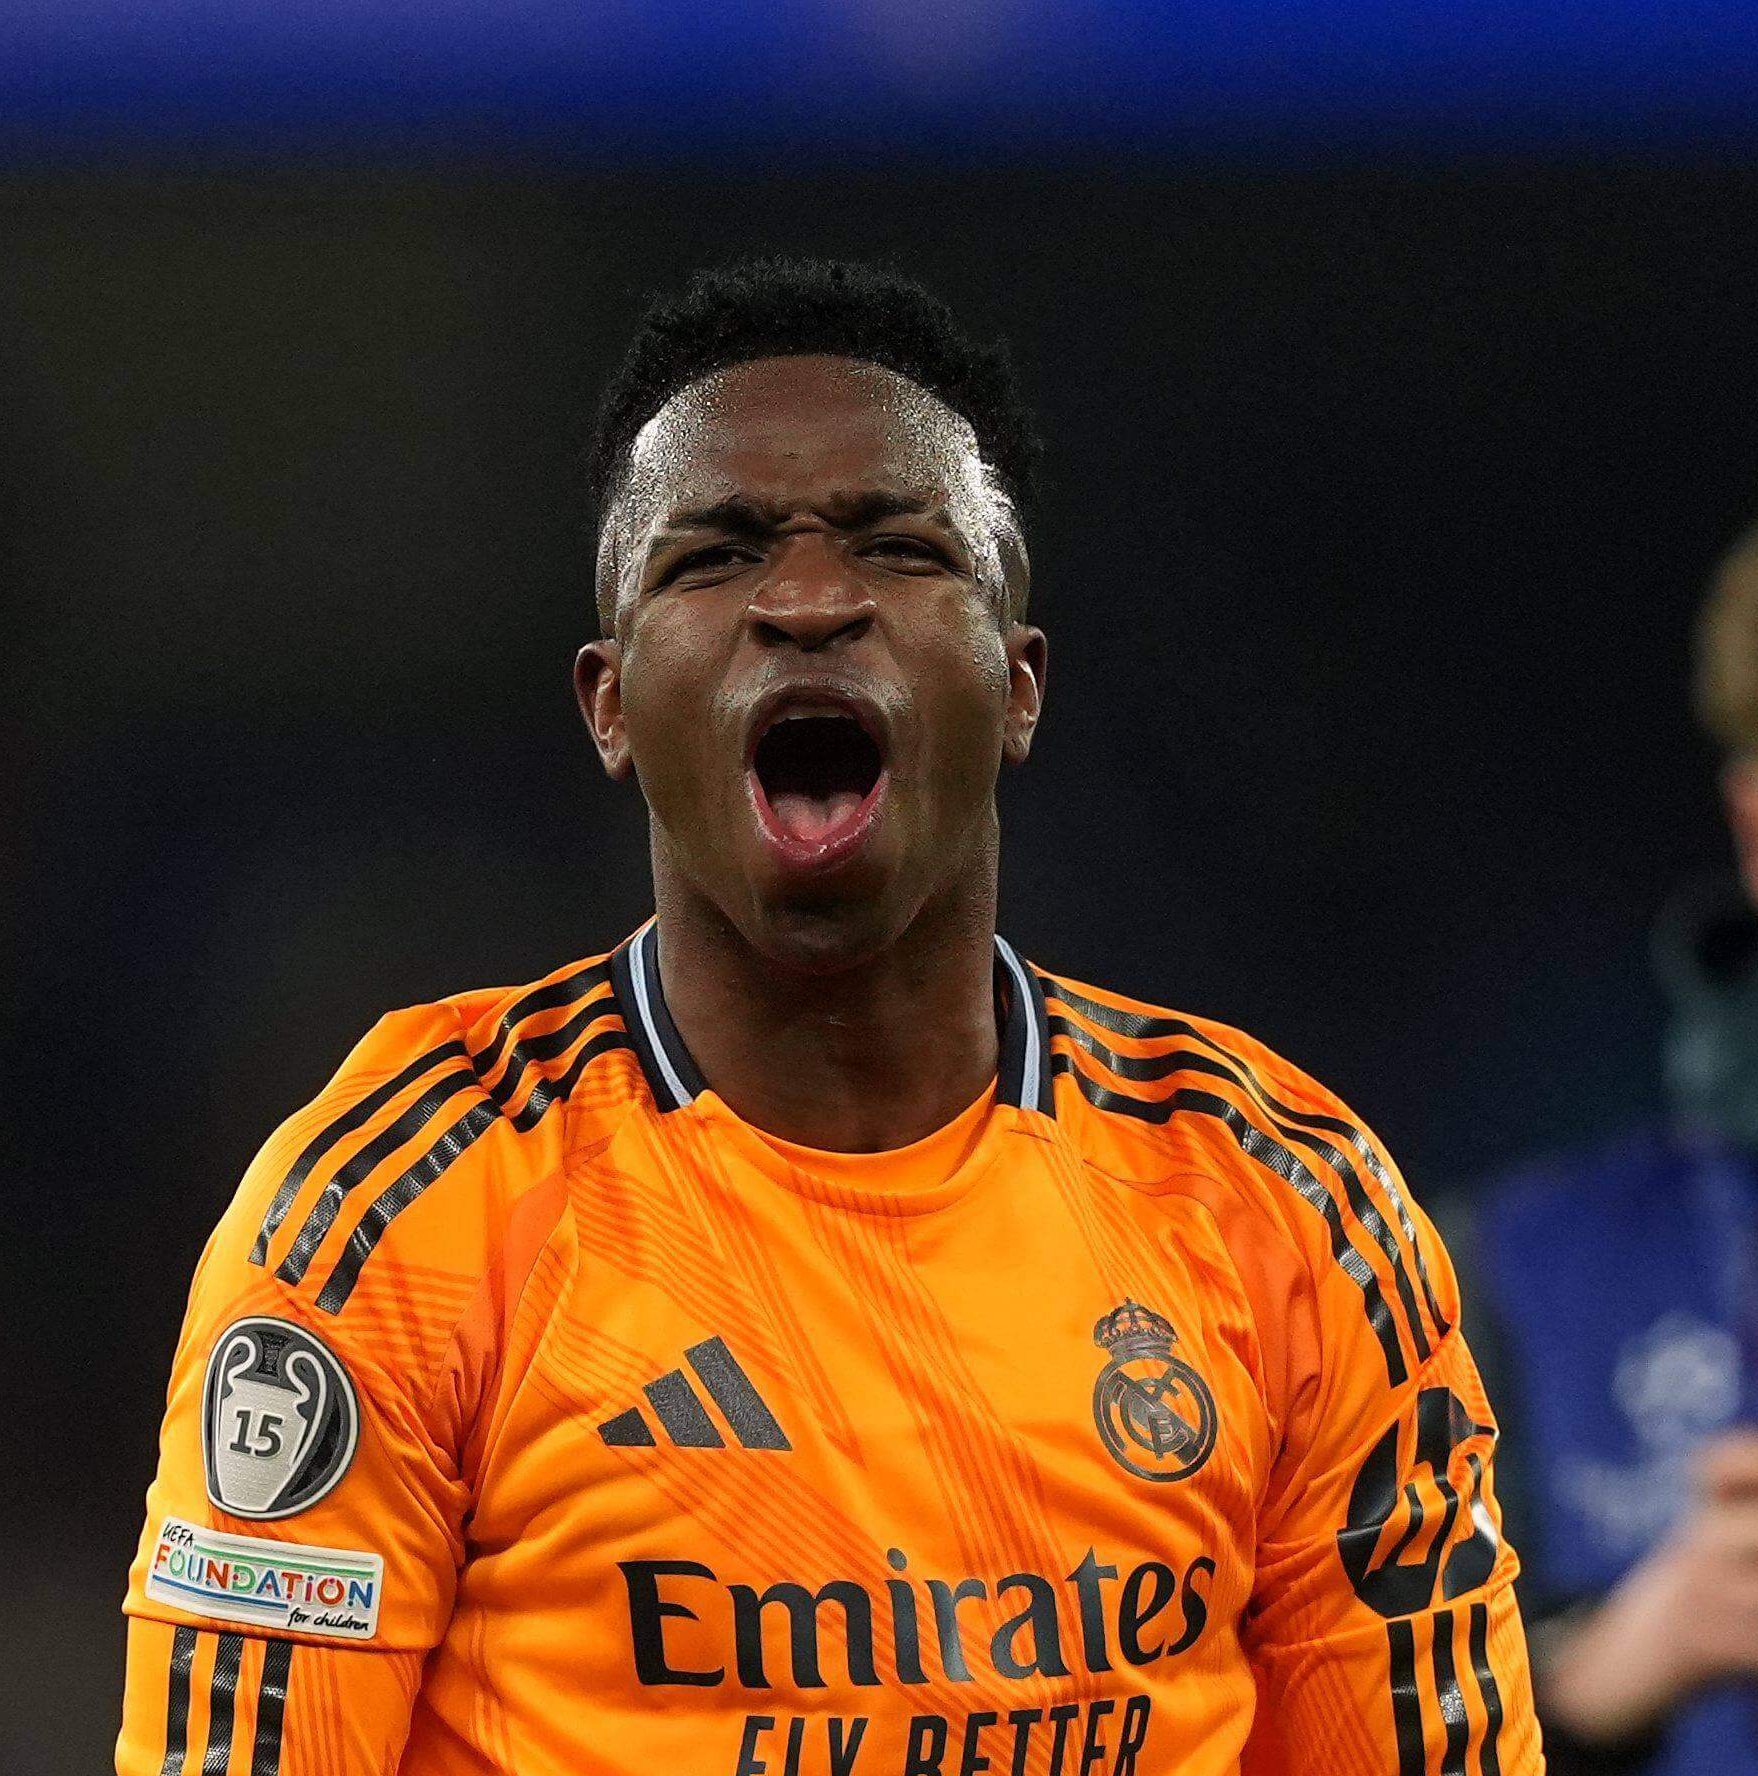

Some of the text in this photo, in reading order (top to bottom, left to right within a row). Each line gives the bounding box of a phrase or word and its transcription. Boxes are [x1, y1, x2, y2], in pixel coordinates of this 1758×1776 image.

[228, 1409, 284, 1459] 15
[162, 1522, 195, 1548] UEFA
[154, 1543, 374, 1609] FOUNDATION
[288, 1607, 369, 1632] for children
[615, 1545, 1217, 1689] Emirates
